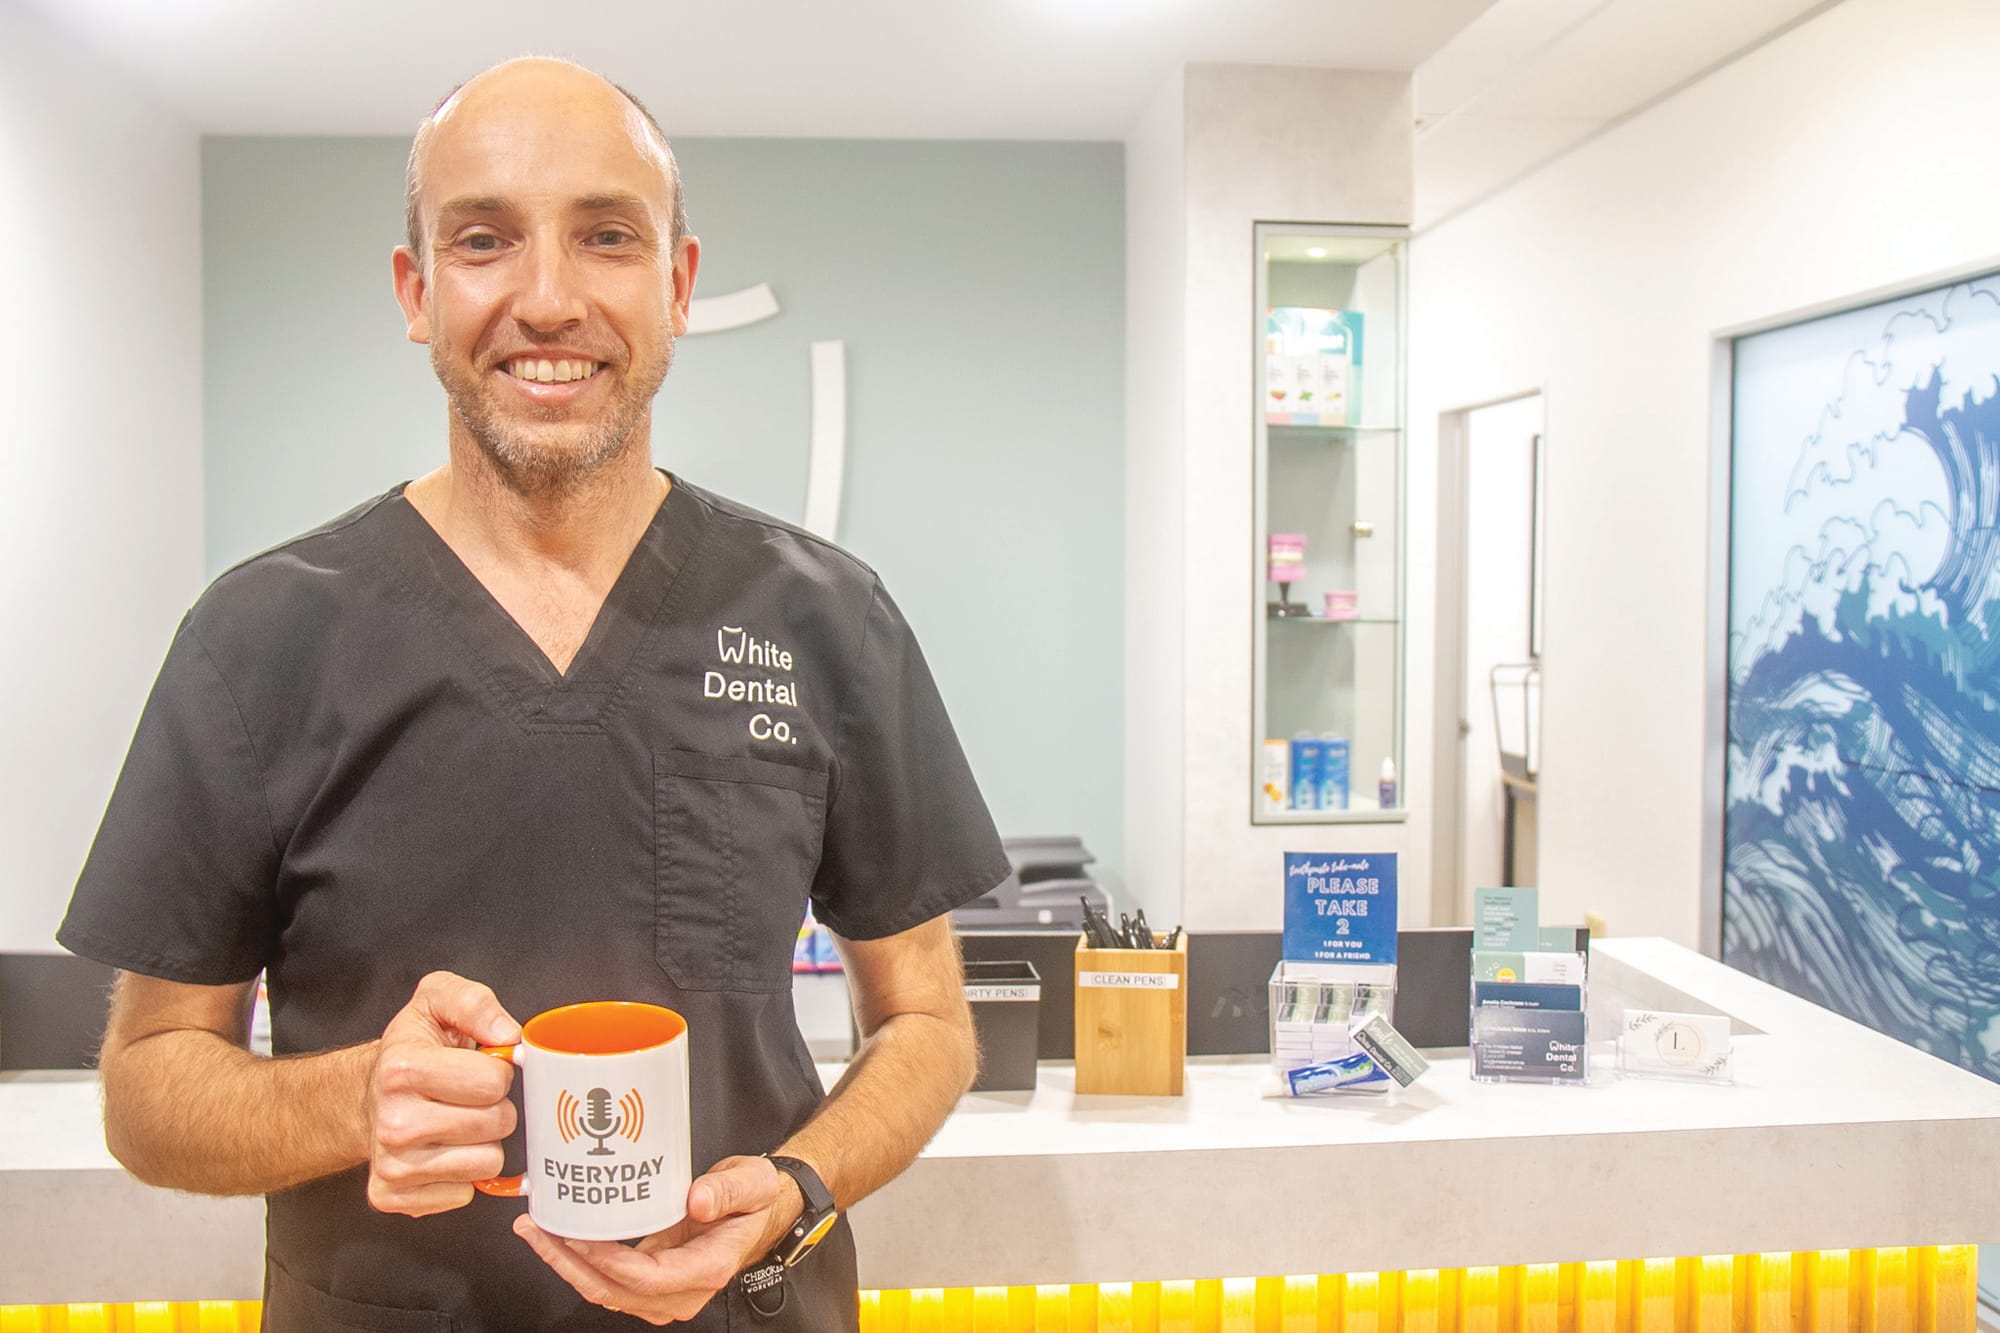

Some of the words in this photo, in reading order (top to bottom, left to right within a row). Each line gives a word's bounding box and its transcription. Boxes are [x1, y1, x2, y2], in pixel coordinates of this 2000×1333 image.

[717, 625, 793, 671] White
[703, 671, 798, 707] Dental
[748, 713, 797, 745] Co.
[1306, 877, 1379, 895] PLEASE
[1314, 899, 1369, 917] TAKE
[1335, 917, 1350, 935] 2
[1327, 940, 1344, 948] FOR
[1344, 940, 1363, 949] YOU
[1319, 951, 1335, 959] FOR
[1343, 952, 1371, 960] FRIEND
[1093, 975, 1131, 985] CLEAN
[1133, 976, 1164, 986] PENS
[966, 988, 992, 998] IRTY
[995, 988, 1025, 998] PENS
[1549, 1040, 1577, 1052] White
[1546, 1052, 1577, 1062] Dental
[1560, 1063, 1577, 1073] Co.
[544, 1155, 664, 1184] EVERYDAY
[557, 1181, 651, 1205] PEOPLE
